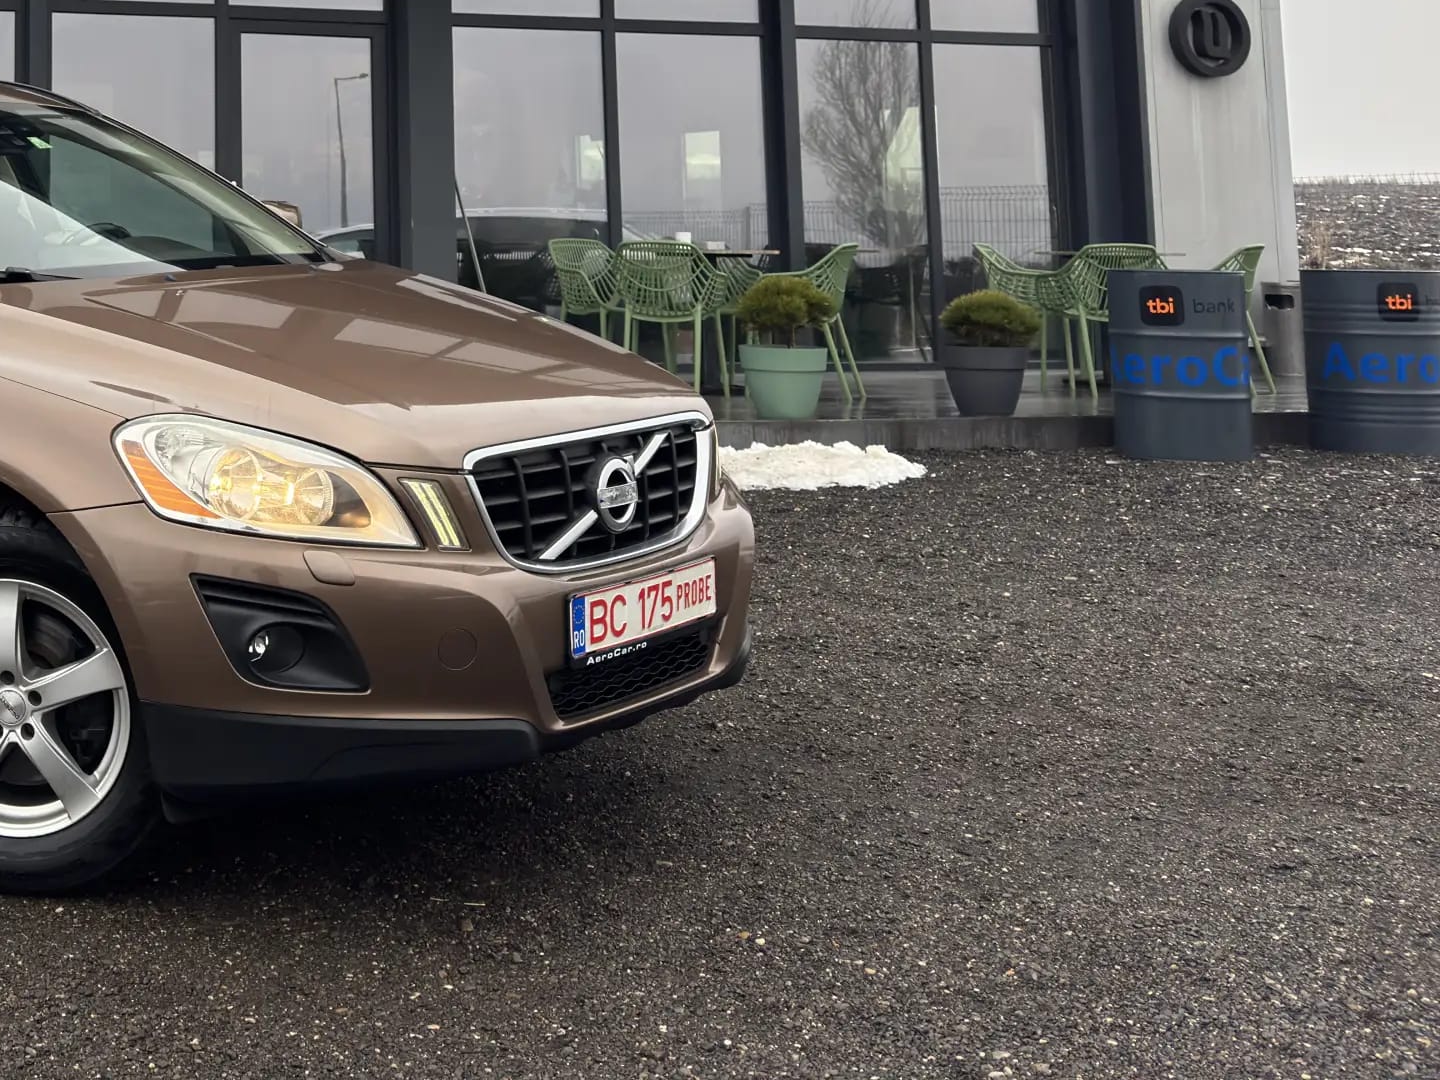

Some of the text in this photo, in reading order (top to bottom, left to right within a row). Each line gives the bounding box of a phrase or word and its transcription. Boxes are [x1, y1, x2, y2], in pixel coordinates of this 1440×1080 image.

[1146, 296, 1236, 314] tbi bank
[1385, 293, 1413, 311] tbi
[573, 573, 712, 649] RO BC 175 PROBE
[586, 641, 648, 666] AeroCar.ro
